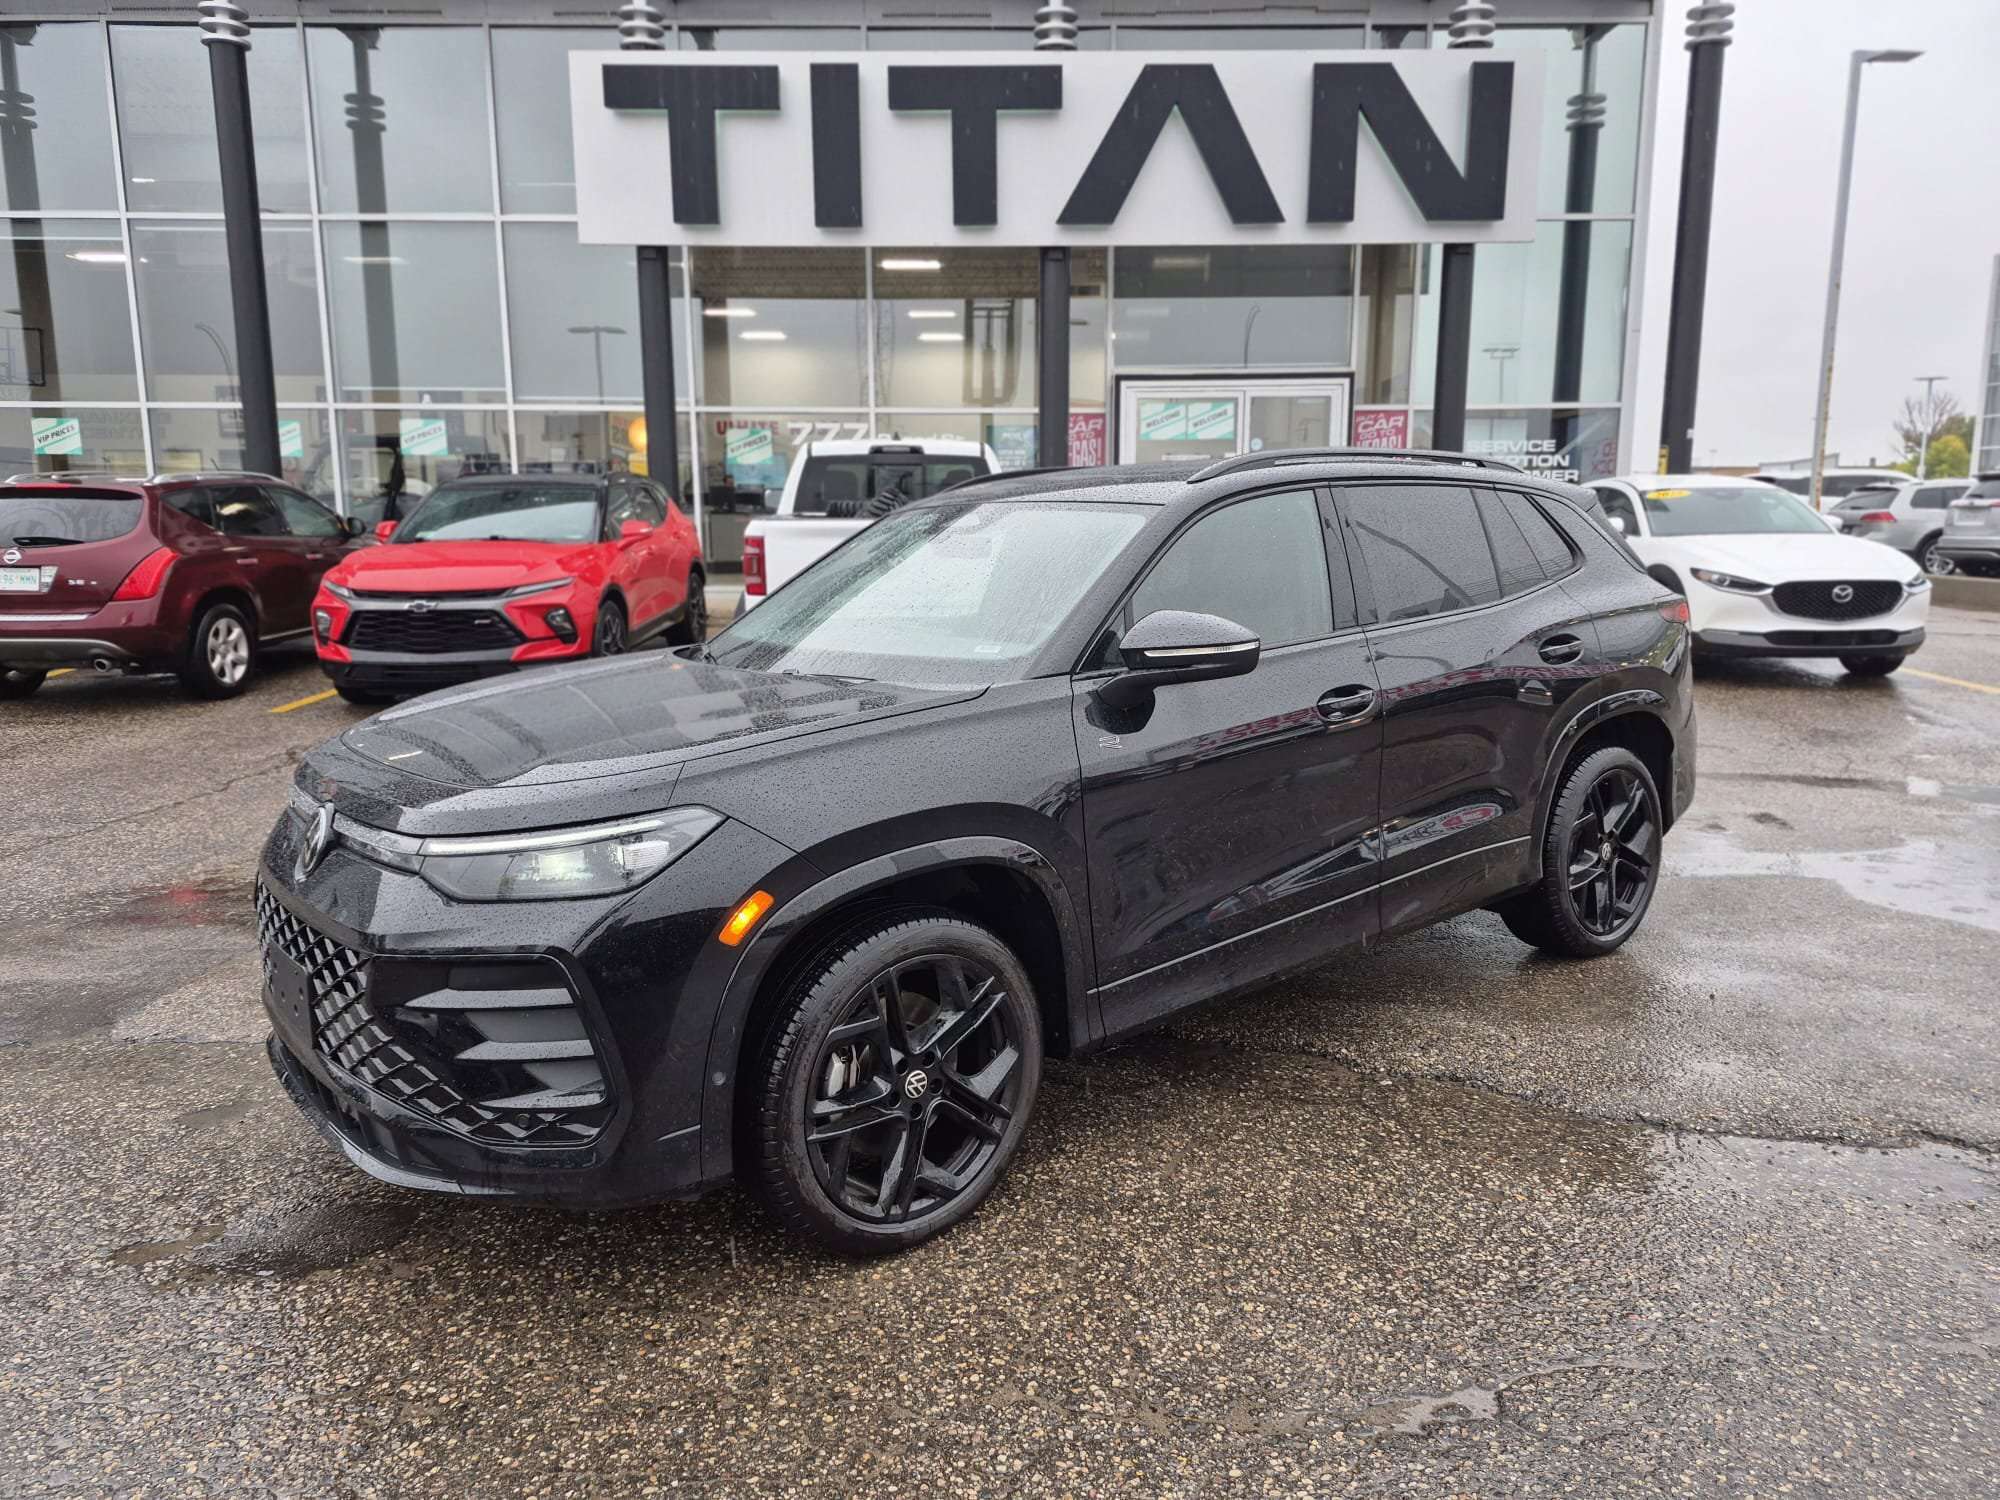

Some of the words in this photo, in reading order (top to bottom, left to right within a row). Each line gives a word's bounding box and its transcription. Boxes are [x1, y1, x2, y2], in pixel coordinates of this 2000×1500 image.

[602, 61, 1515, 228] TITAN
[1358, 415, 1404, 433] CAR
[37, 434, 50, 444] VIP
[51, 425, 75, 439] PRICES
[1068, 438, 1102, 468] GAS!
[1466, 439, 1557, 453] SERVICE
[1504, 454, 1570, 467] PTION
